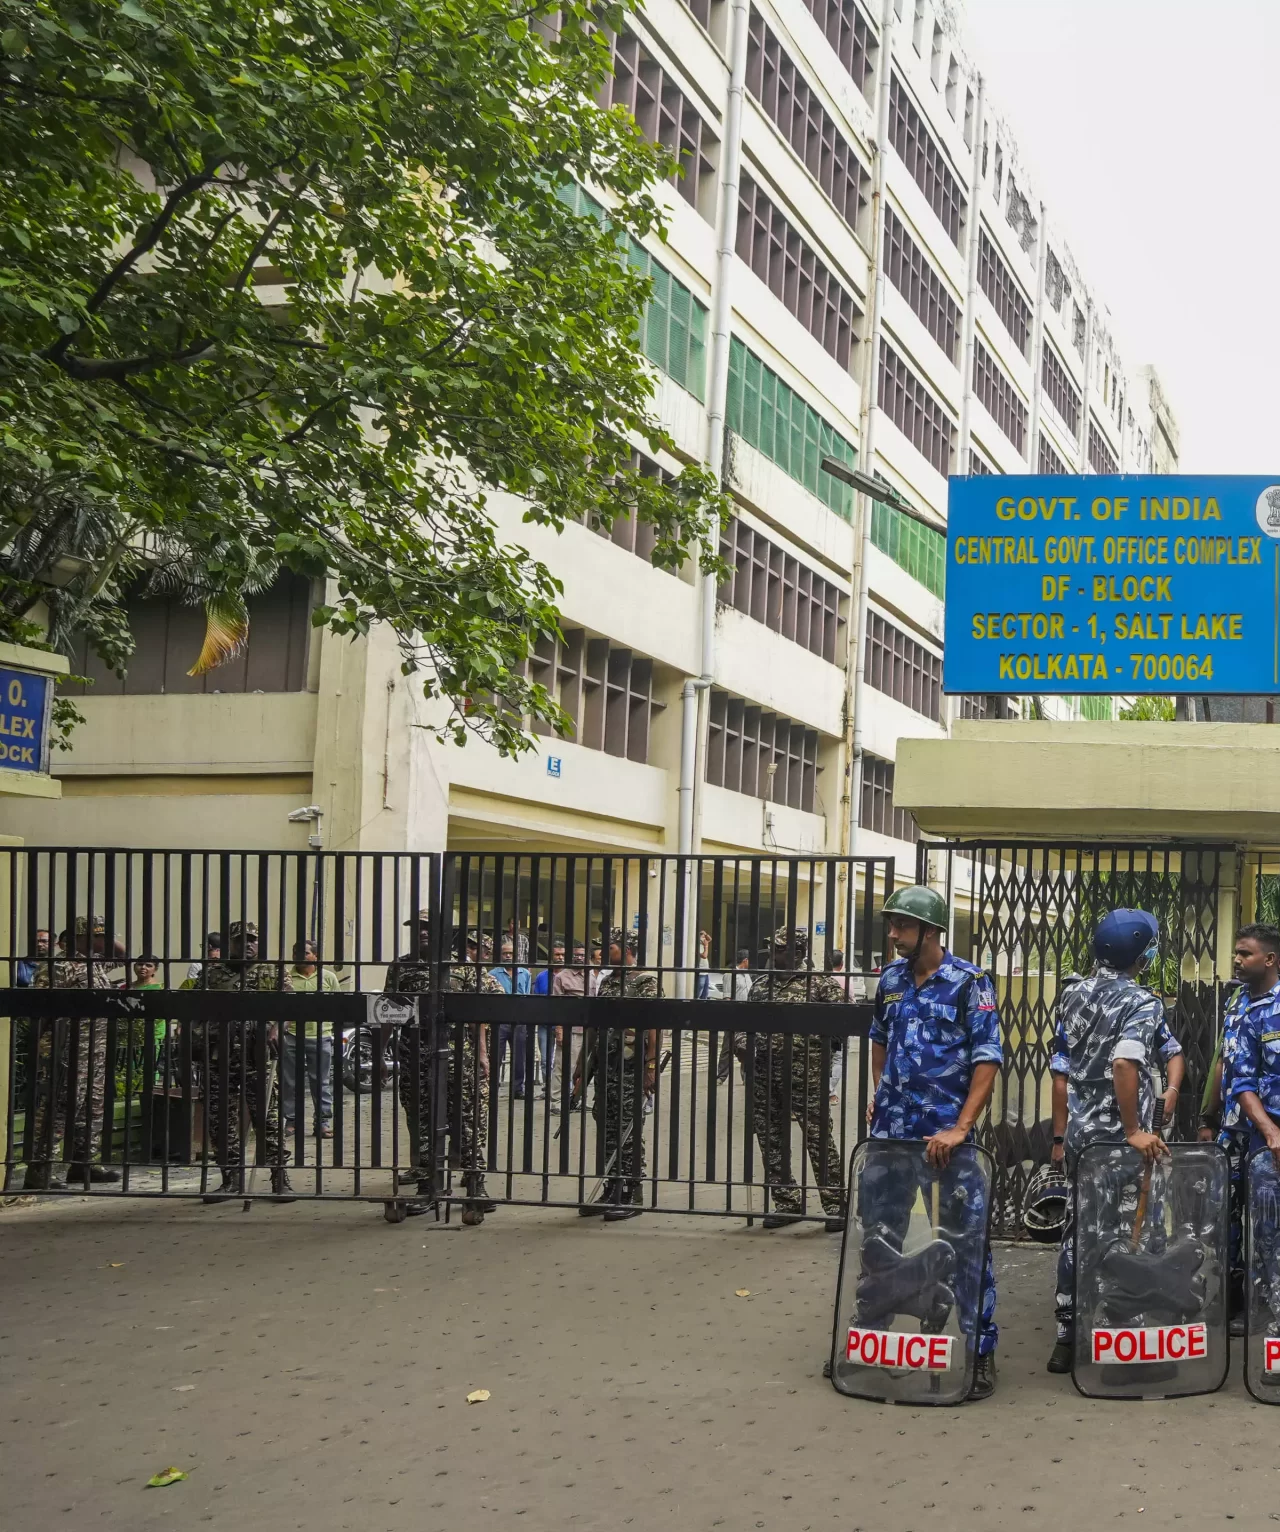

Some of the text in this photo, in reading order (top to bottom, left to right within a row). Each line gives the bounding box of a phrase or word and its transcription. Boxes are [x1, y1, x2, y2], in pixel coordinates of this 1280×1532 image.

[995, 496, 1223, 521] GOVT. OF INDIA
[954, 535, 1262, 565] CENTRAL GOVT. OFFICE COMPLEX
[1041, 574, 1071, 602] DF
[1092, 574, 1173, 602] BLOCK
[971, 612, 1065, 640] SECTOR
[1114, 613, 1174, 640] SALT
[1180, 613, 1244, 640] LAKE
[999, 652, 1109, 680] KOLKATA
[1129, 653, 1214, 681] 700064
[846, 1330, 949, 1369] POLICE
[1093, 1325, 1205, 1361] POLICE
